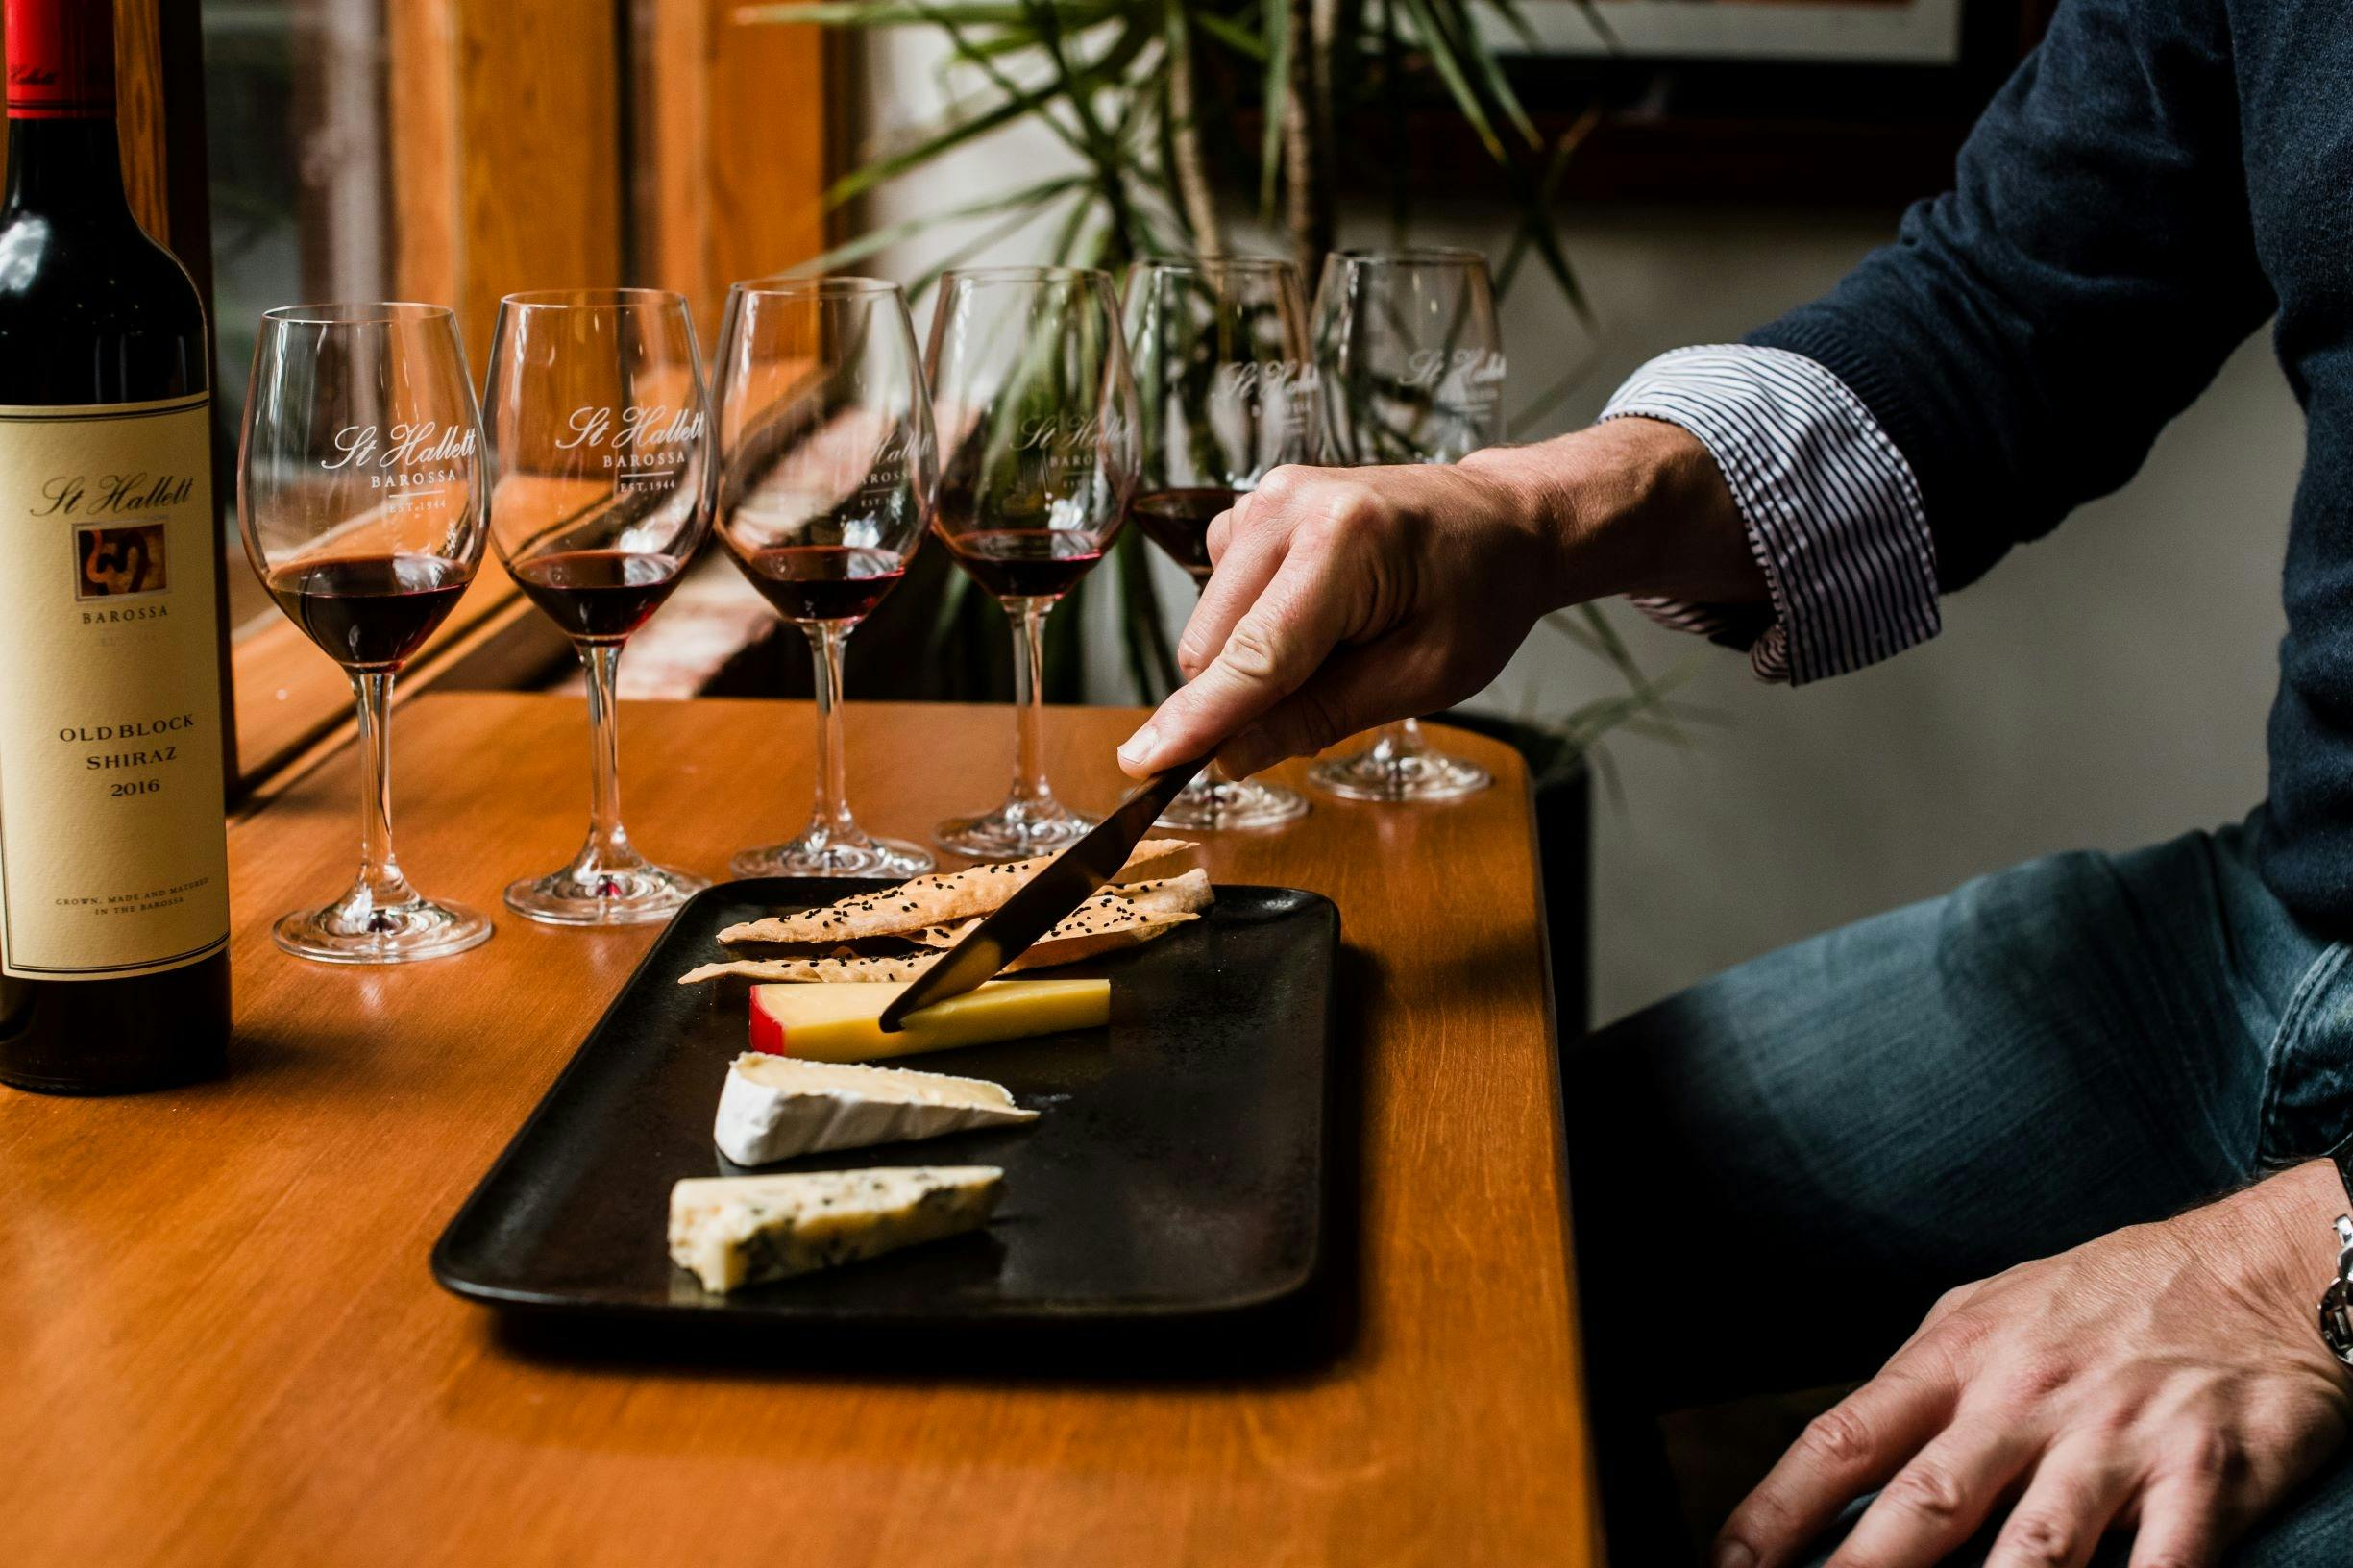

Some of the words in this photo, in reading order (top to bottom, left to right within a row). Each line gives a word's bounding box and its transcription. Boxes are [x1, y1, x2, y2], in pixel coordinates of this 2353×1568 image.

[555, 406, 611, 450] St
[610, 404, 705, 449] Hallett
[321, 425, 378, 470] St
[379, 421, 477, 468] Hallett
[603, 451, 686, 468] BAROSSA
[371, 469, 456, 488] BAROSSA
[30, 476, 85, 517] St
[86, 472, 194, 515] Hallett
[83, 605, 169, 625] BAROSSA
[60, 726, 112, 743] OLD
[119, 714, 195, 739] BLOCK
[86, 747, 177, 771] SHIRAZ
[110, 778, 160, 796] 2016
[108, 894, 139, 904] MADE
[144, 889, 167, 899] AND
[114, 905, 135, 915] THE
[140, 896, 184, 912] BAROSSA
